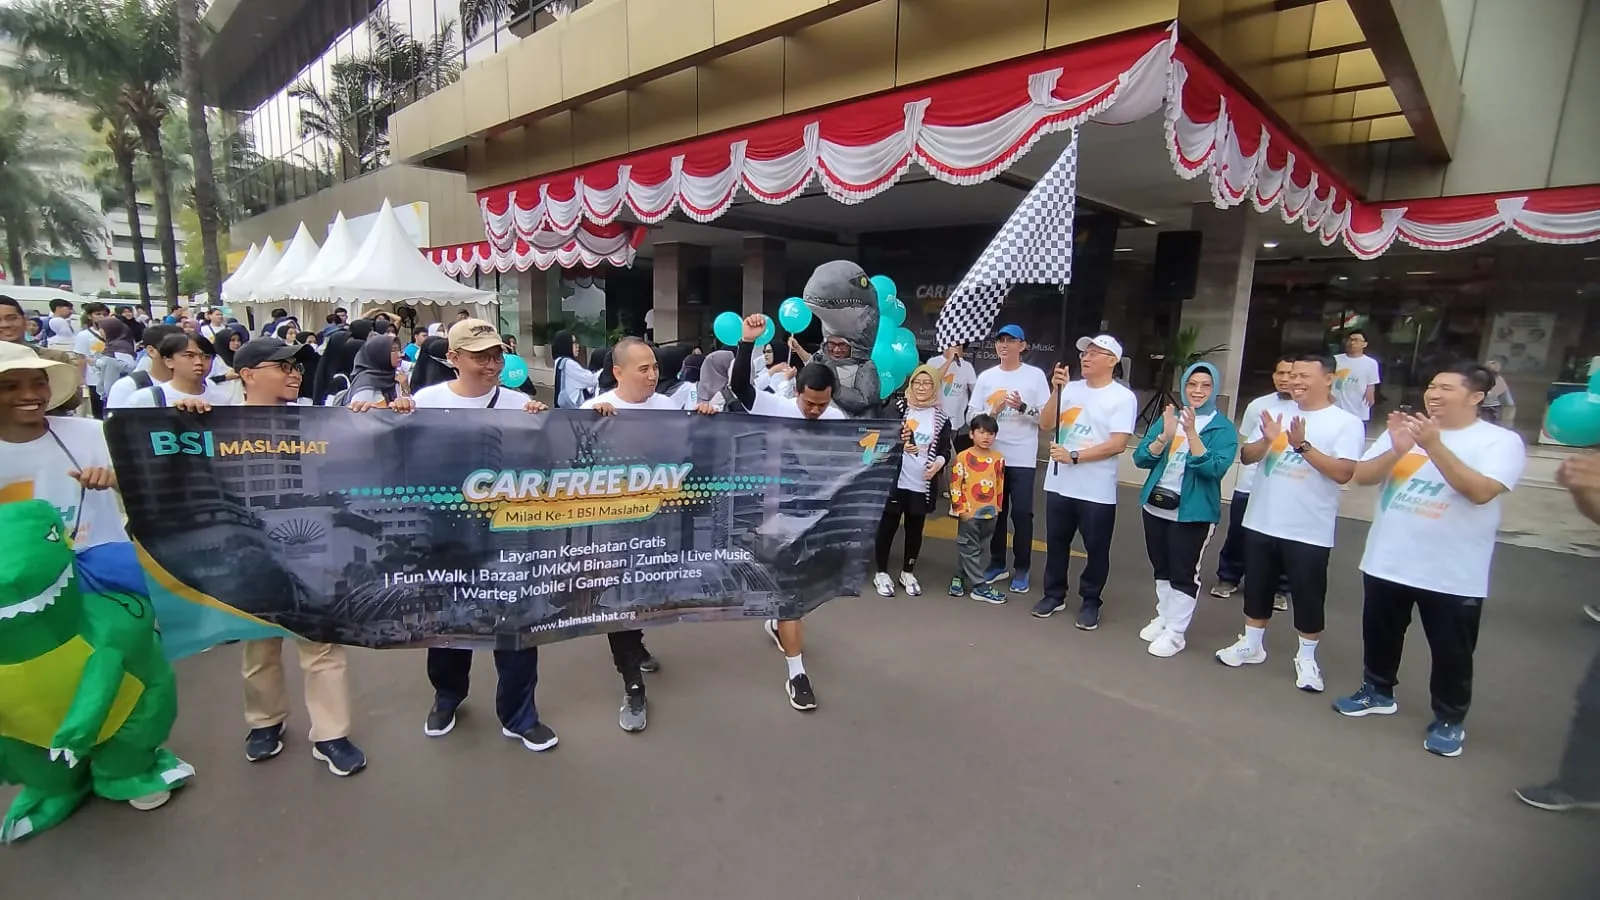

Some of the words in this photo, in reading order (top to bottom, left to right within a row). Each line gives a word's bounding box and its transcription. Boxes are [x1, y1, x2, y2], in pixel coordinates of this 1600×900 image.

[150, 431, 214, 457] BSI
[219, 440, 329, 456] MASLAHAT
[464, 470, 544, 500] CAR
[548, 466, 624, 498] FREE
[627, 464, 691, 493] DAY
[1406, 478, 1445, 497] TH
[506, 510, 541, 523] Milad
[546, 509, 573, 521] Ke-1
[577, 507, 596, 519] BSI
[599, 504, 650, 517] Maslahat
[500, 549, 556, 564] Layanan
[560, 540, 627, 557] Kesehatan
[629, 536, 667, 550] Gratis
[394, 571, 424, 585] Fun
[427, 569, 467, 583] Walk
[480, 569, 530, 582] Bazaar
[532, 561, 580, 578] UMKM
[584, 557, 627, 571] Binaan
[636, 552, 678, 566] Zumba
[688, 550, 712, 562] Live
[714, 548, 750, 561] Music
[461, 587, 517, 602] Warteg
[520, 580, 565, 599] Mobile
[576, 575, 619, 589] Games
[622, 572, 632, 583] &
[635, 568, 702, 583] Doorprizes
[530, 610, 636, 632] www.bsimaslahat.org
